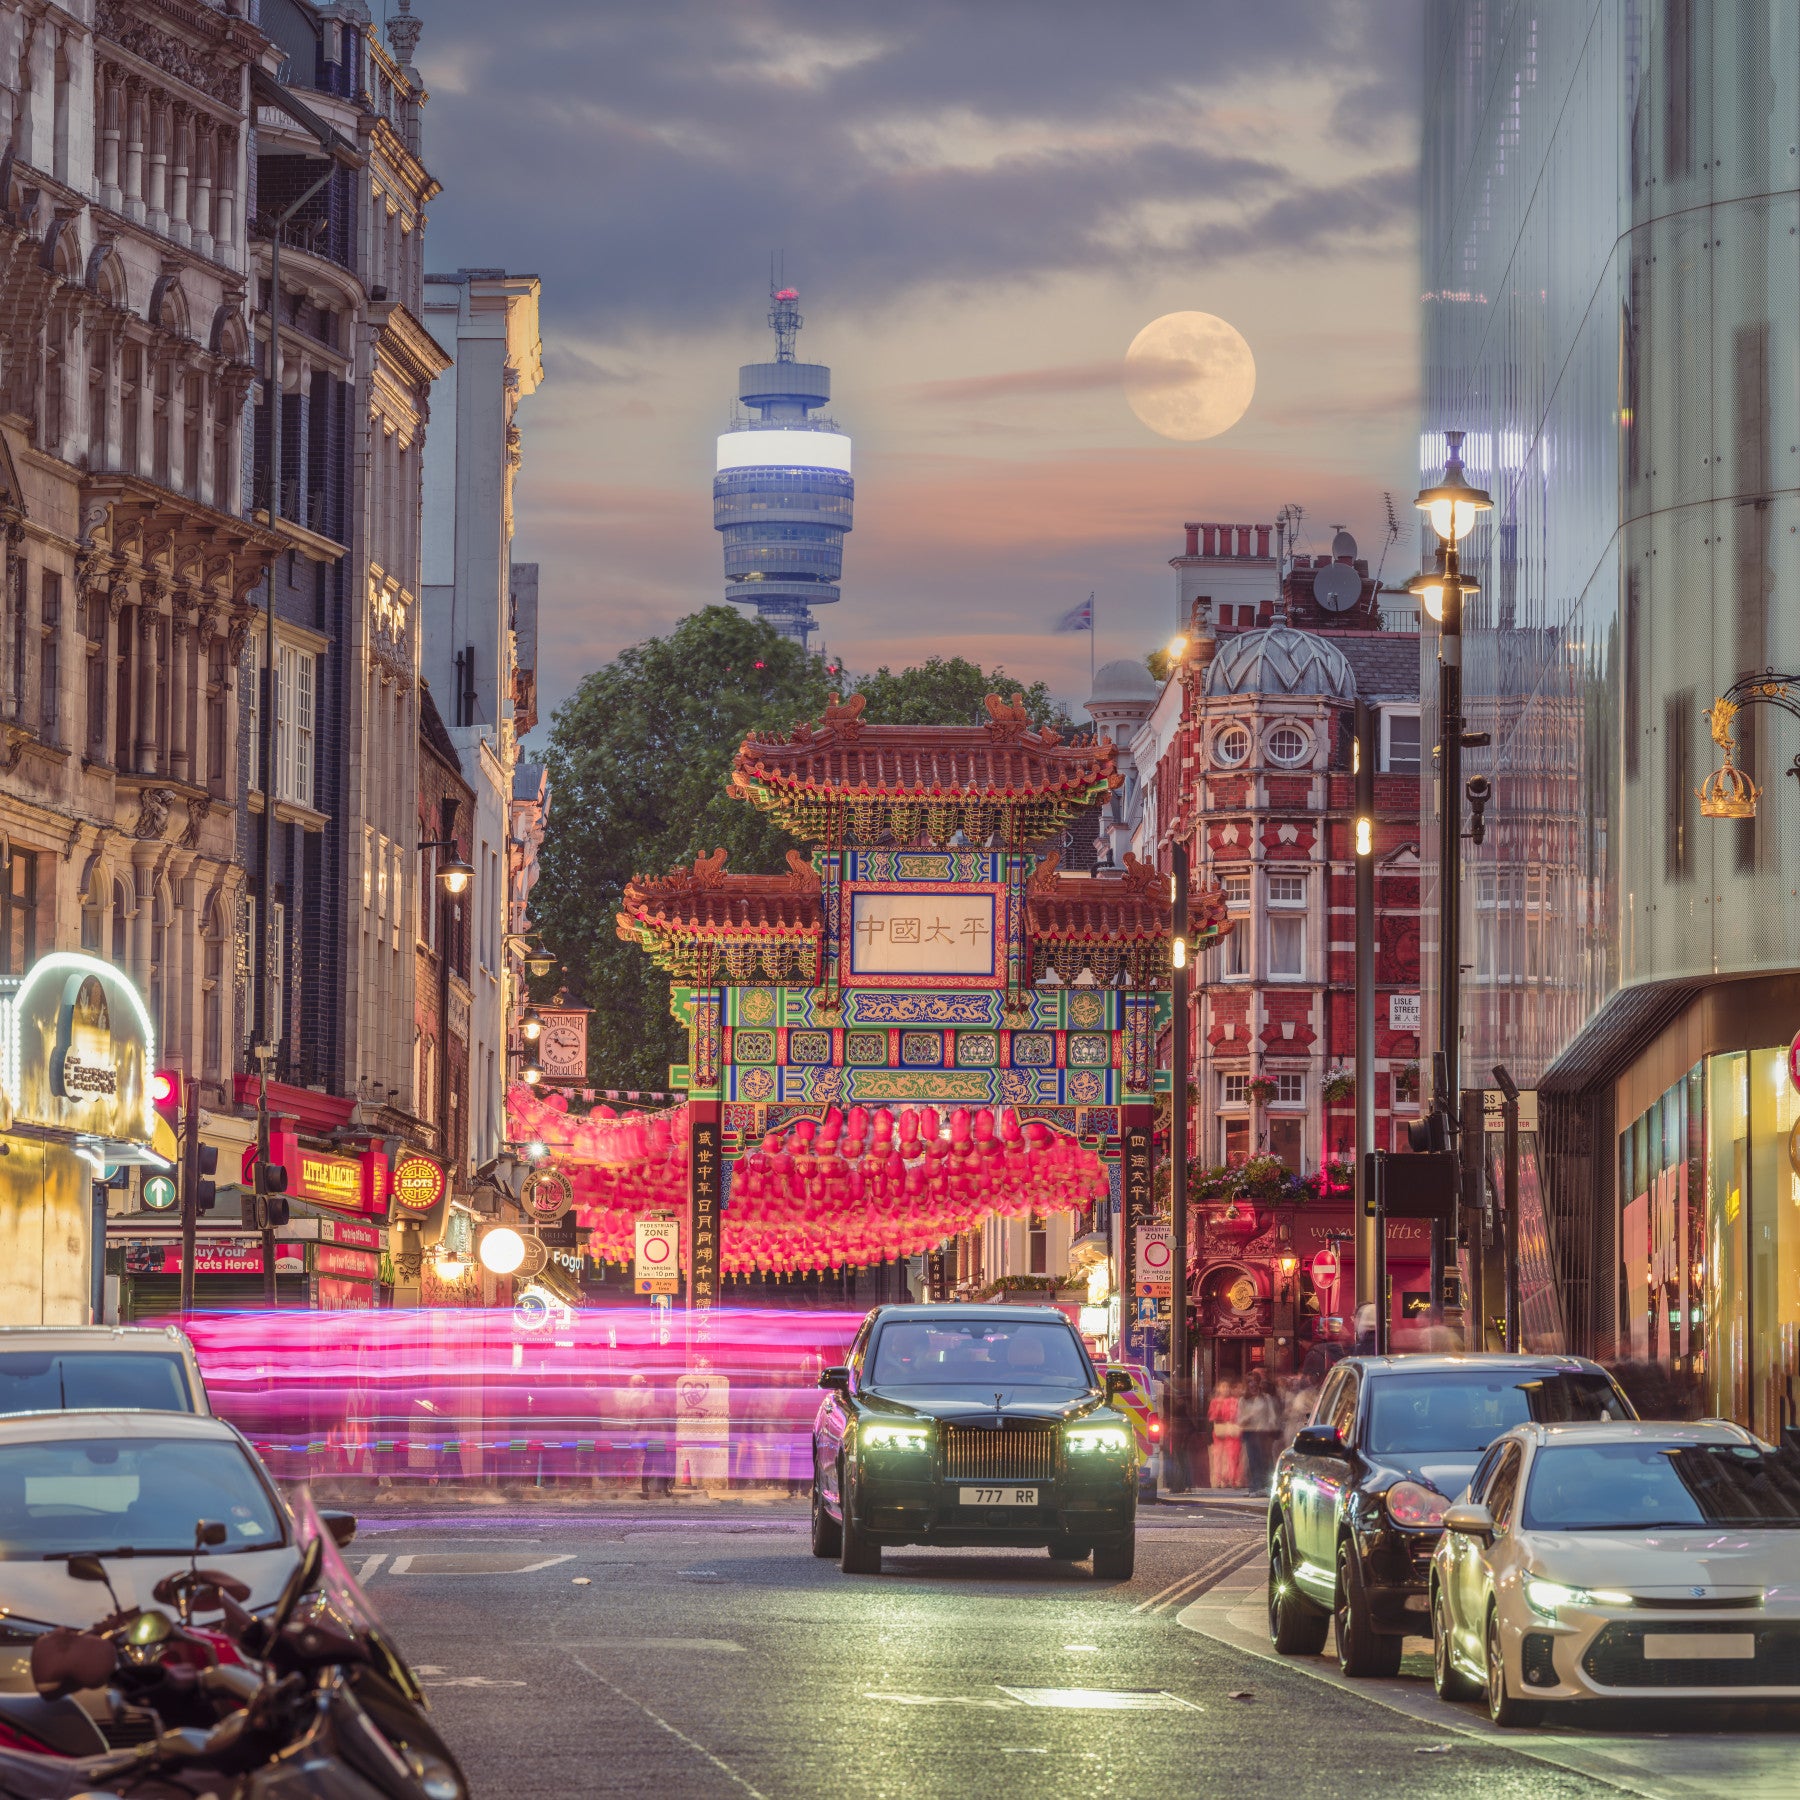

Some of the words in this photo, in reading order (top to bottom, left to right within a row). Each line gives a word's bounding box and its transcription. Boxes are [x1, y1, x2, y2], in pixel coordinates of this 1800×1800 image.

[856, 914, 989, 946] 中國太平
[1394, 997, 1412, 1005] LISLE
[303, 1159, 329, 1184] LITTLE
[329, 1164, 355, 1188] MACAU
[401, 1178, 433, 1188] SLOTS
[523, 1173, 539, 1193] WAXY
[533, 1210, 557, 1219] LONDON
[217, 1247, 247, 1257] Your
[176, 1260, 222, 1270] Tkets
[225, 1259, 259, 1269] Here!
[975, 1489, 1003, 1503] 777
[1015, 1489, 1034, 1503] RR
